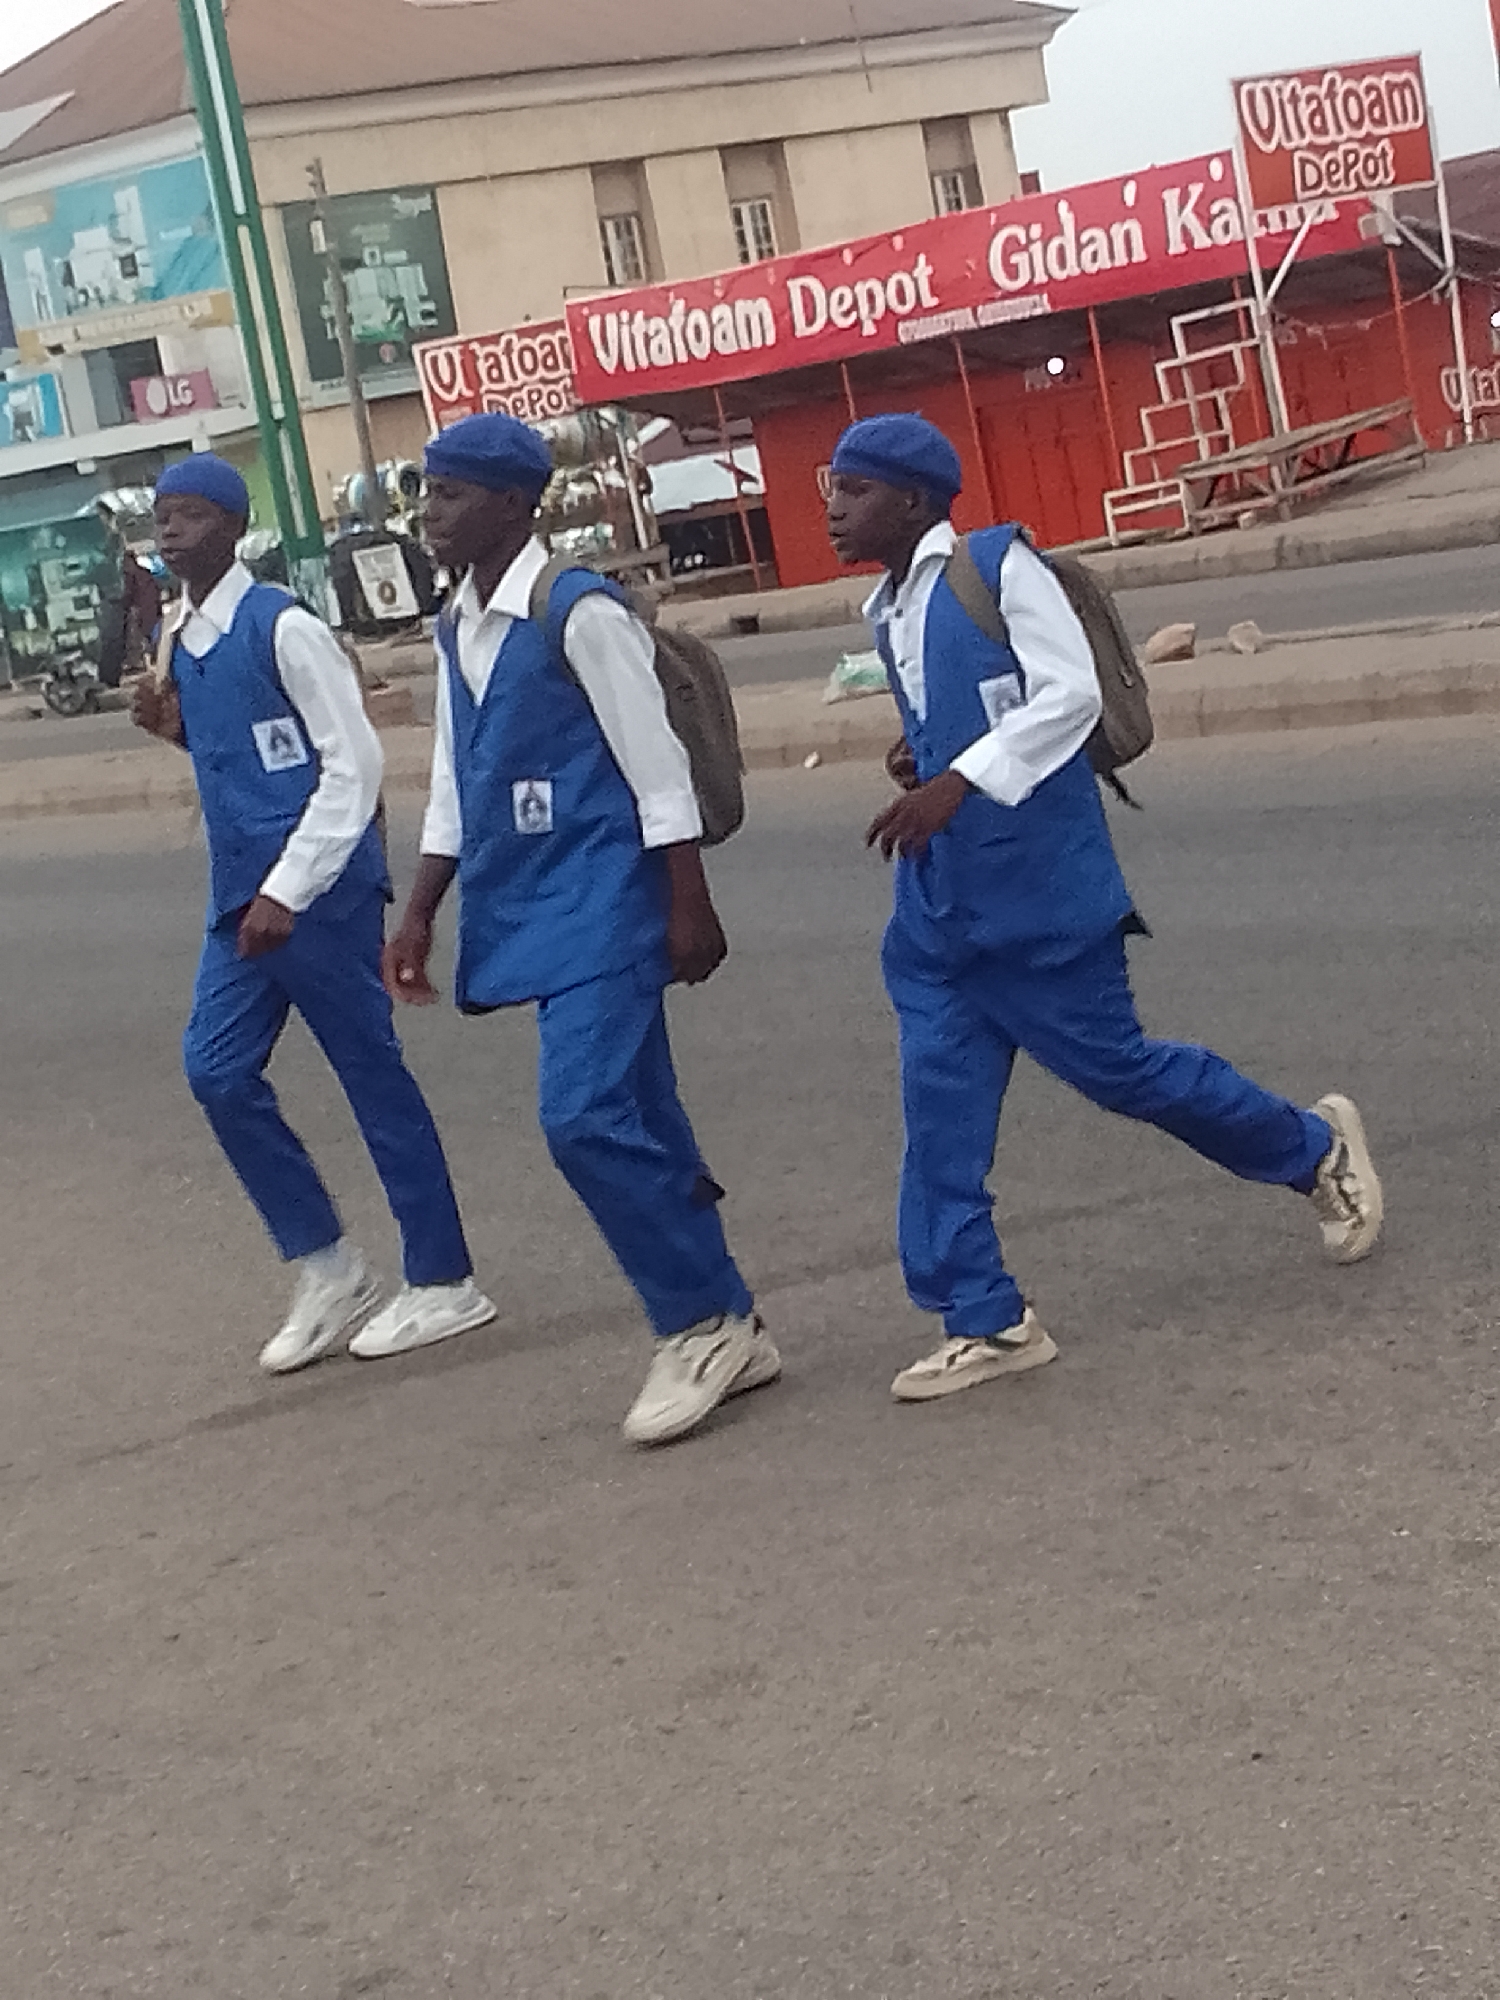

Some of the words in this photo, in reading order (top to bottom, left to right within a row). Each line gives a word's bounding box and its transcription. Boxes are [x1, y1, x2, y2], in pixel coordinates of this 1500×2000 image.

[1240, 70, 1424, 153] Vitafoam
[588, 296, 776, 374] Vitafoam
[786, 252, 939, 338] Depot
[168, 378, 195, 406] LG
